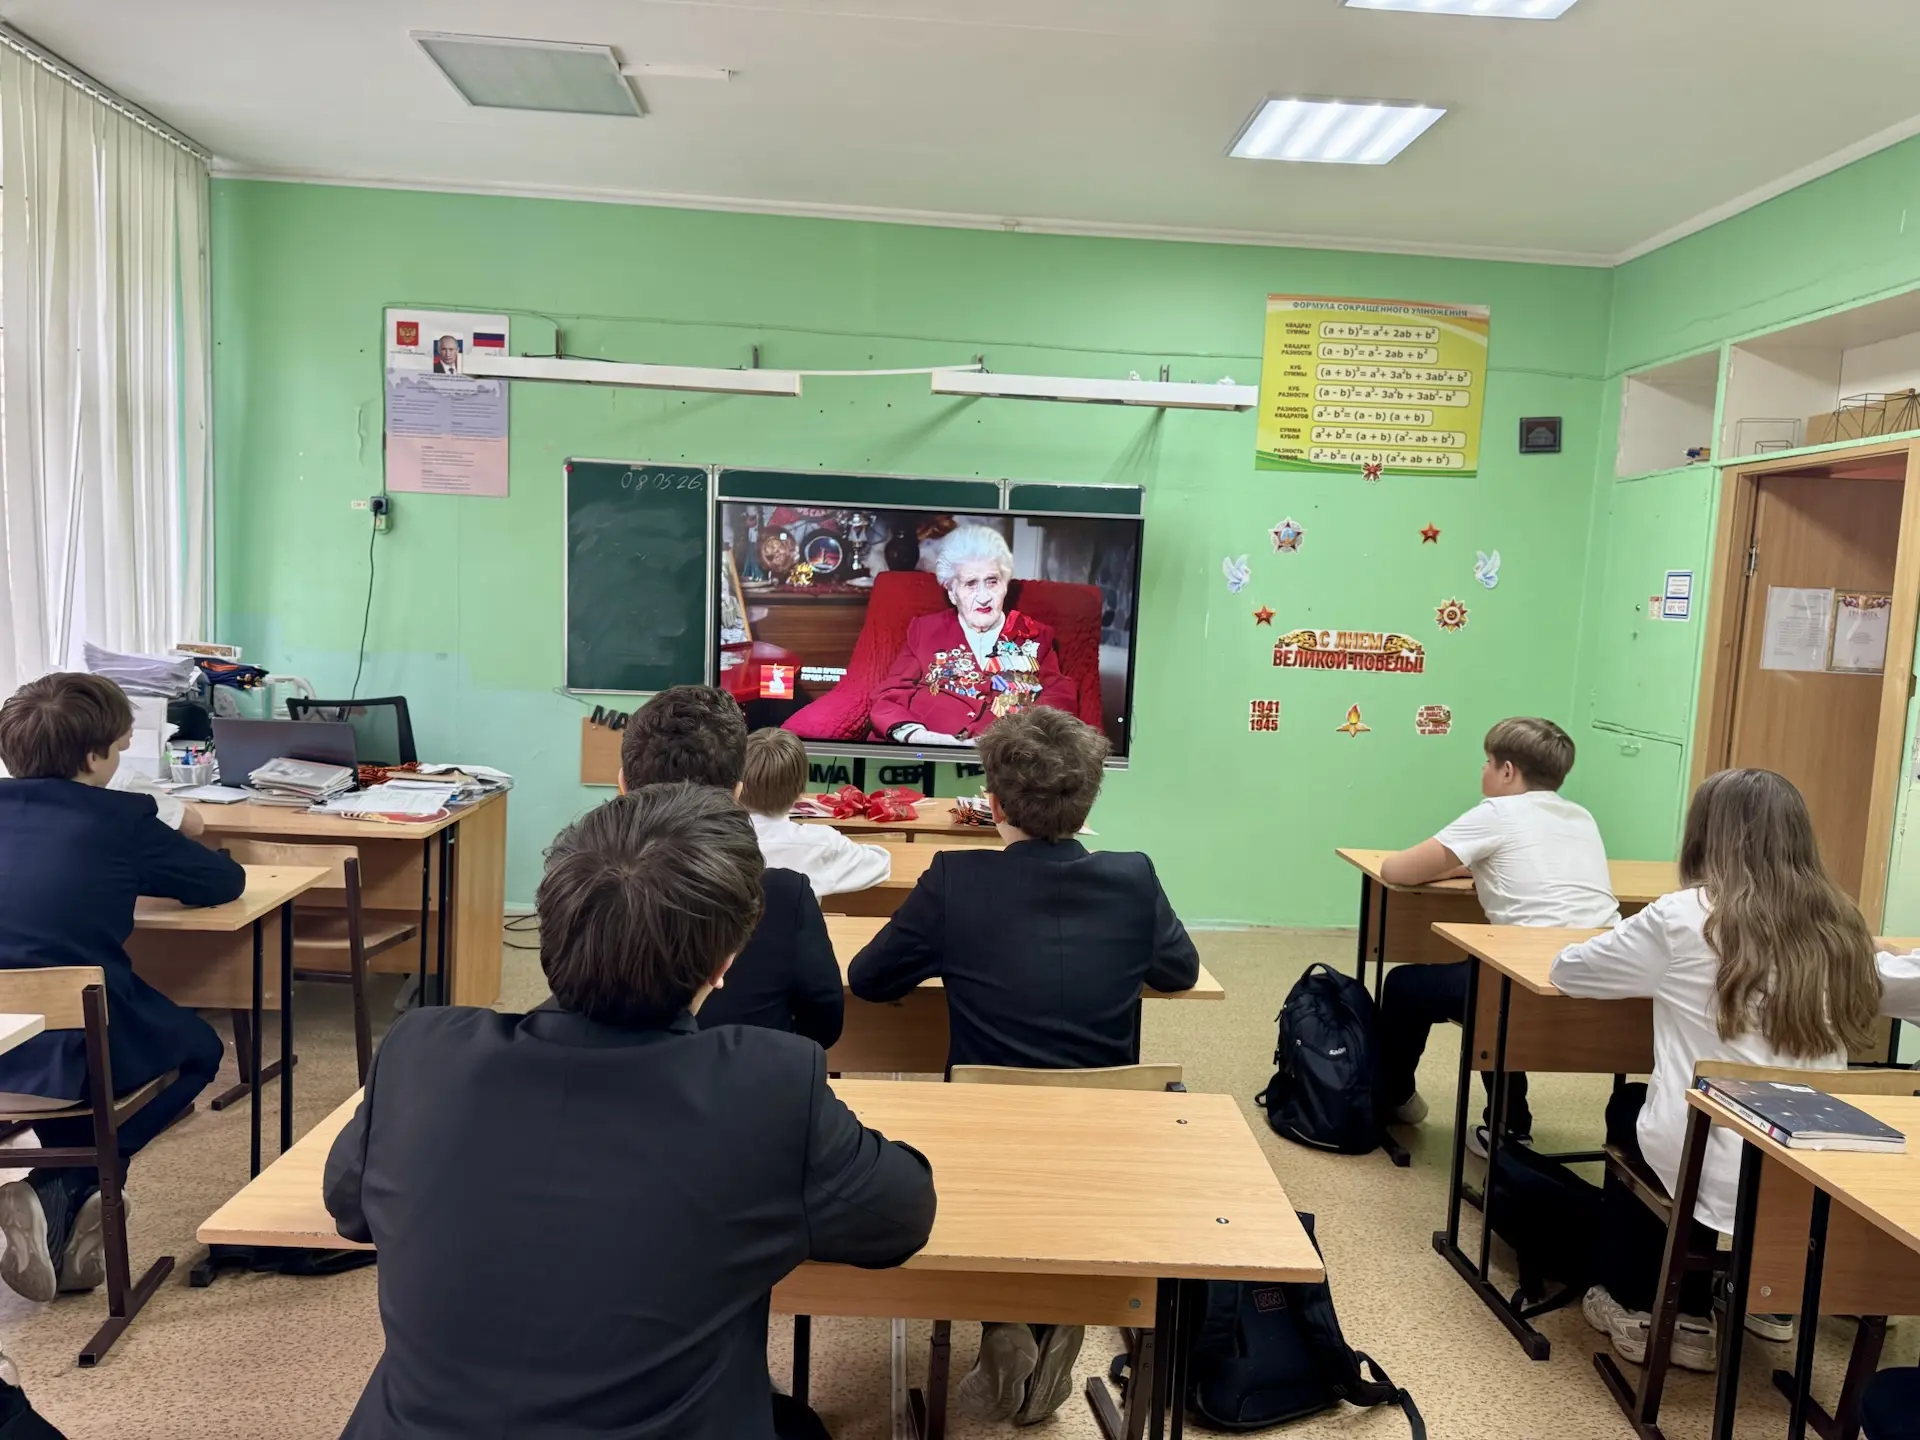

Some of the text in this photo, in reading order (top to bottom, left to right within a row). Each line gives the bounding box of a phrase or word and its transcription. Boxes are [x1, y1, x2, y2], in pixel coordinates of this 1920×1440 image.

[1292, 301, 1335, 310] ФОРМУЛА
[1411, 307, 1468, 317] УМНОЖЕНИЯ
[1319, 631, 1383, 650] С ДНЕМ
[1273, 649, 1424, 672] ВЕЛИКОЙ ПОБЕДЫ!
[1251, 700, 1280, 713] 1941
[590, 704, 628, 730] МА
[1250, 719, 1278, 731] 1945
[809, 763, 851, 784] МА
